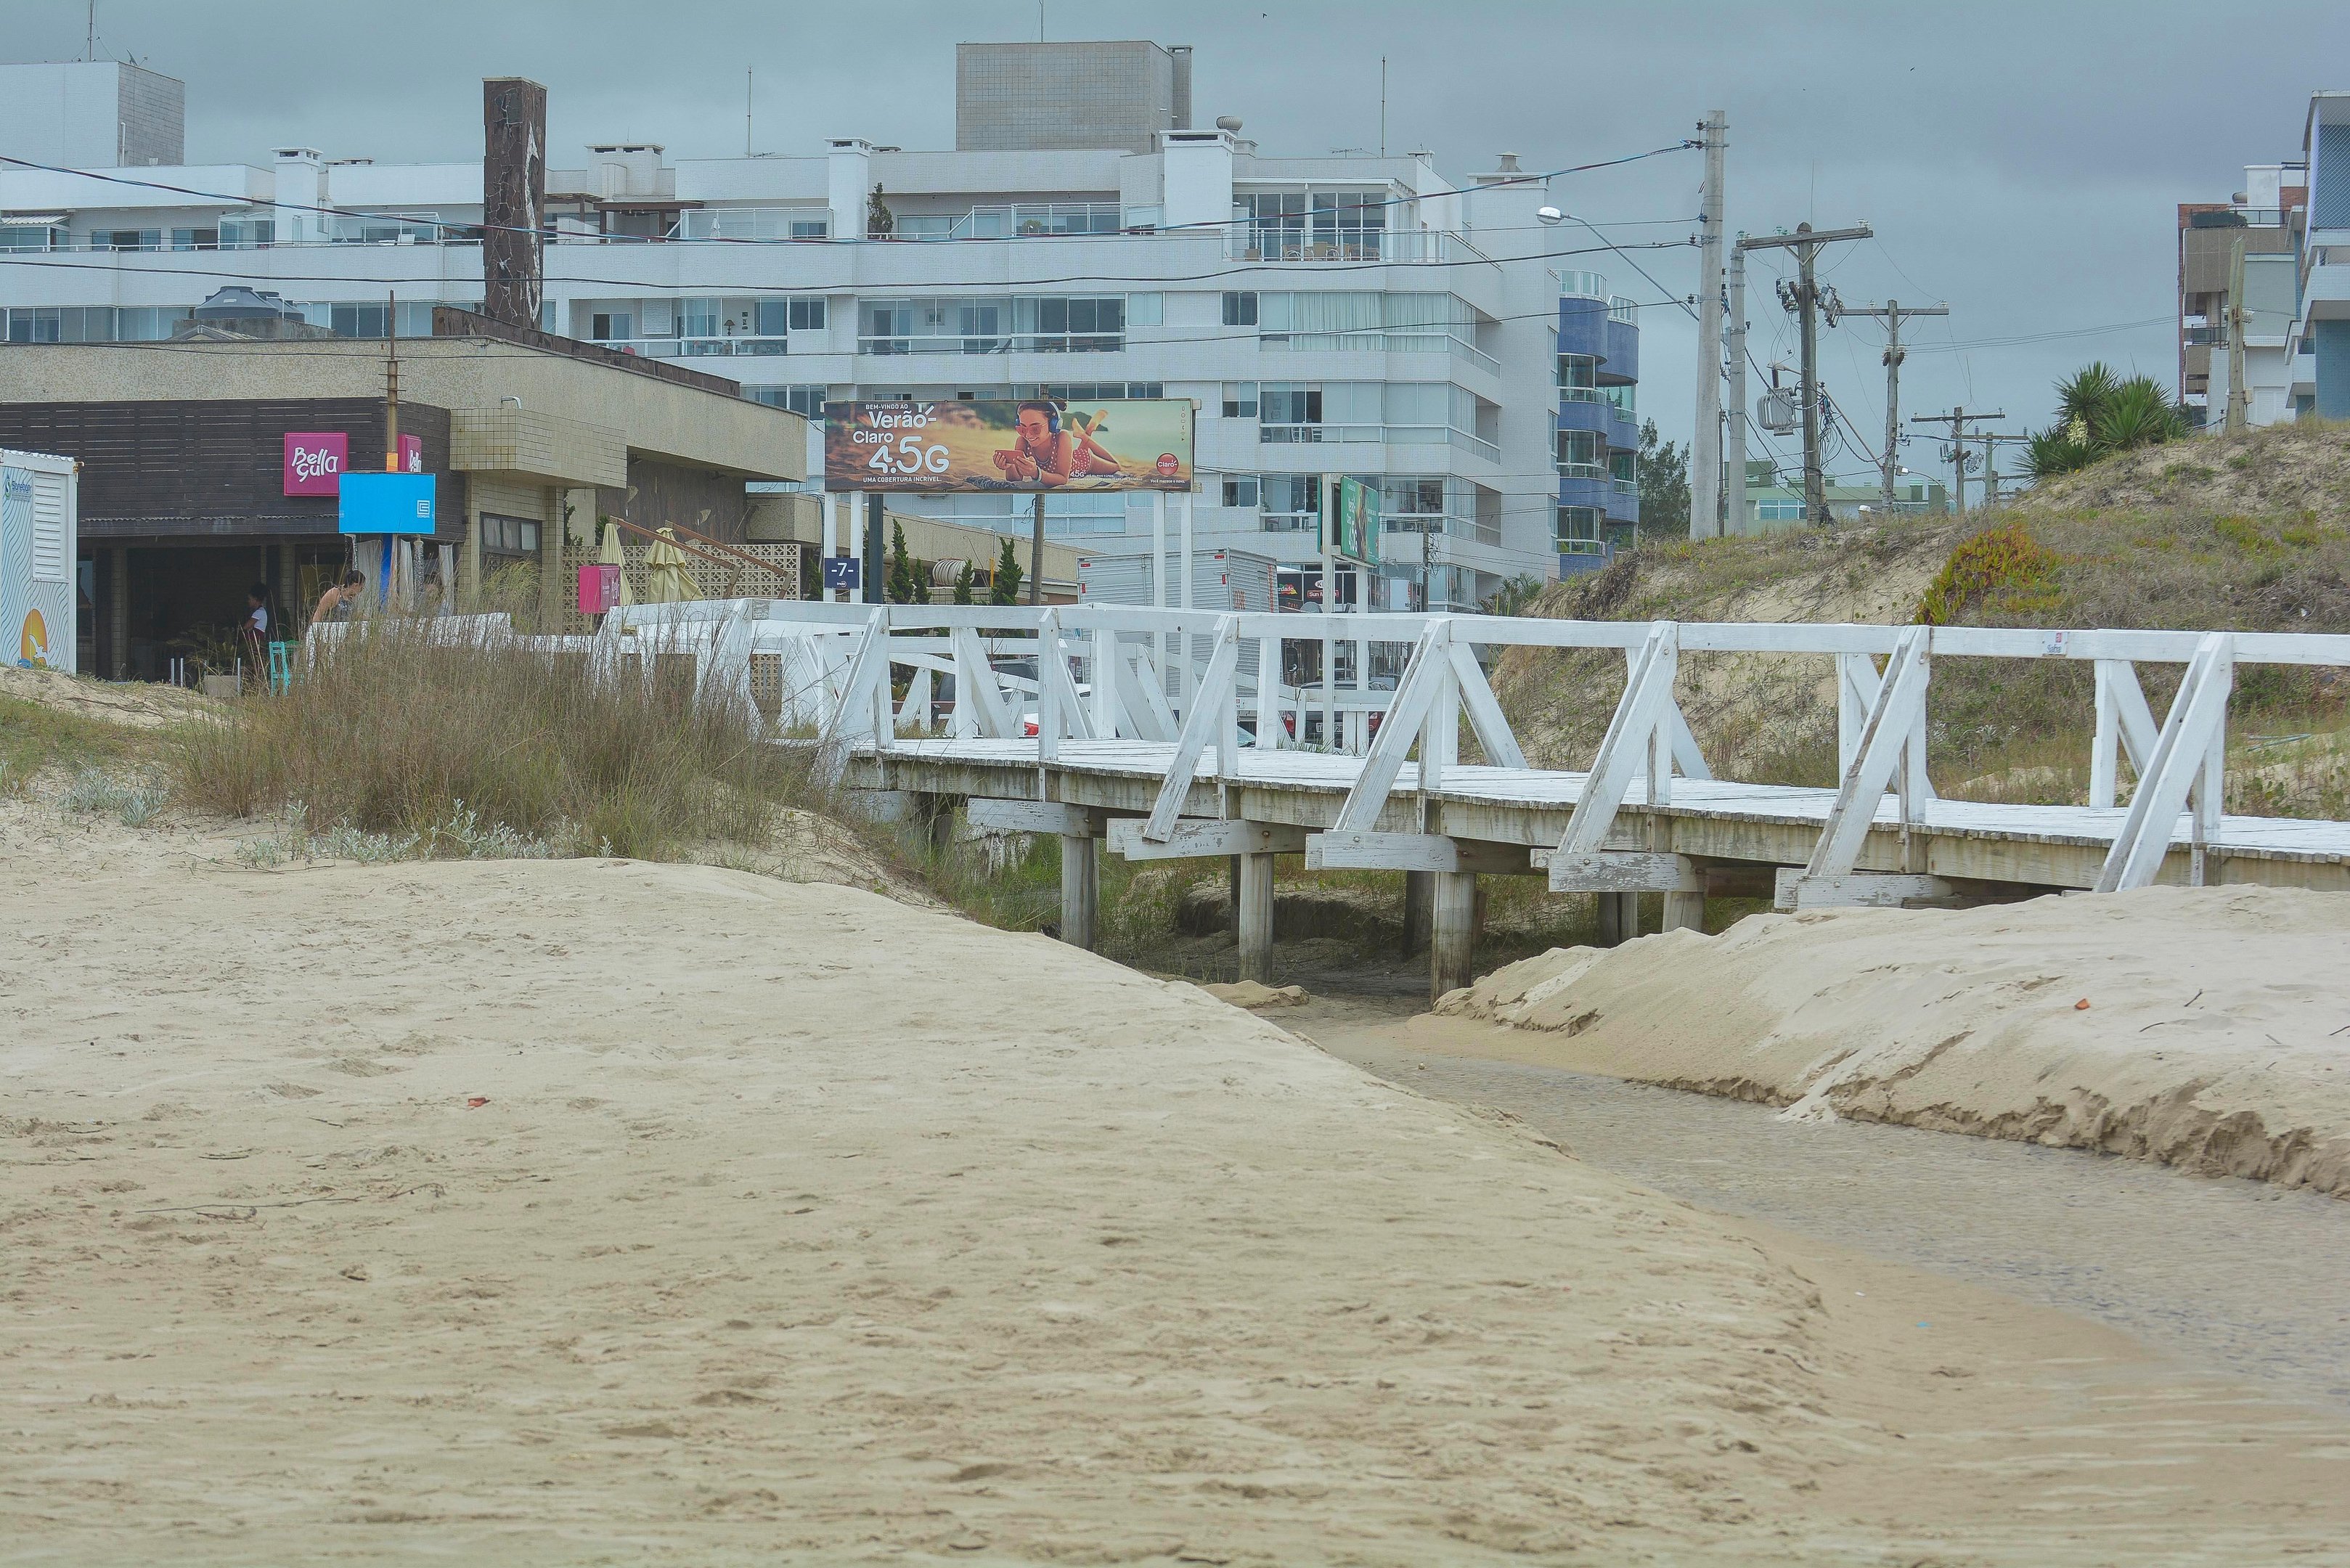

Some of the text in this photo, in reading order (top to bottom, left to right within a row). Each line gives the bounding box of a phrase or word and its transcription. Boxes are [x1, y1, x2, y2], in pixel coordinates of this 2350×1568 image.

[868, 408, 929, 428] Verão
[852, 430, 894, 444] Claro
[292, 446, 338, 473] Bella
[869, 436, 950, 474] 4.5G
